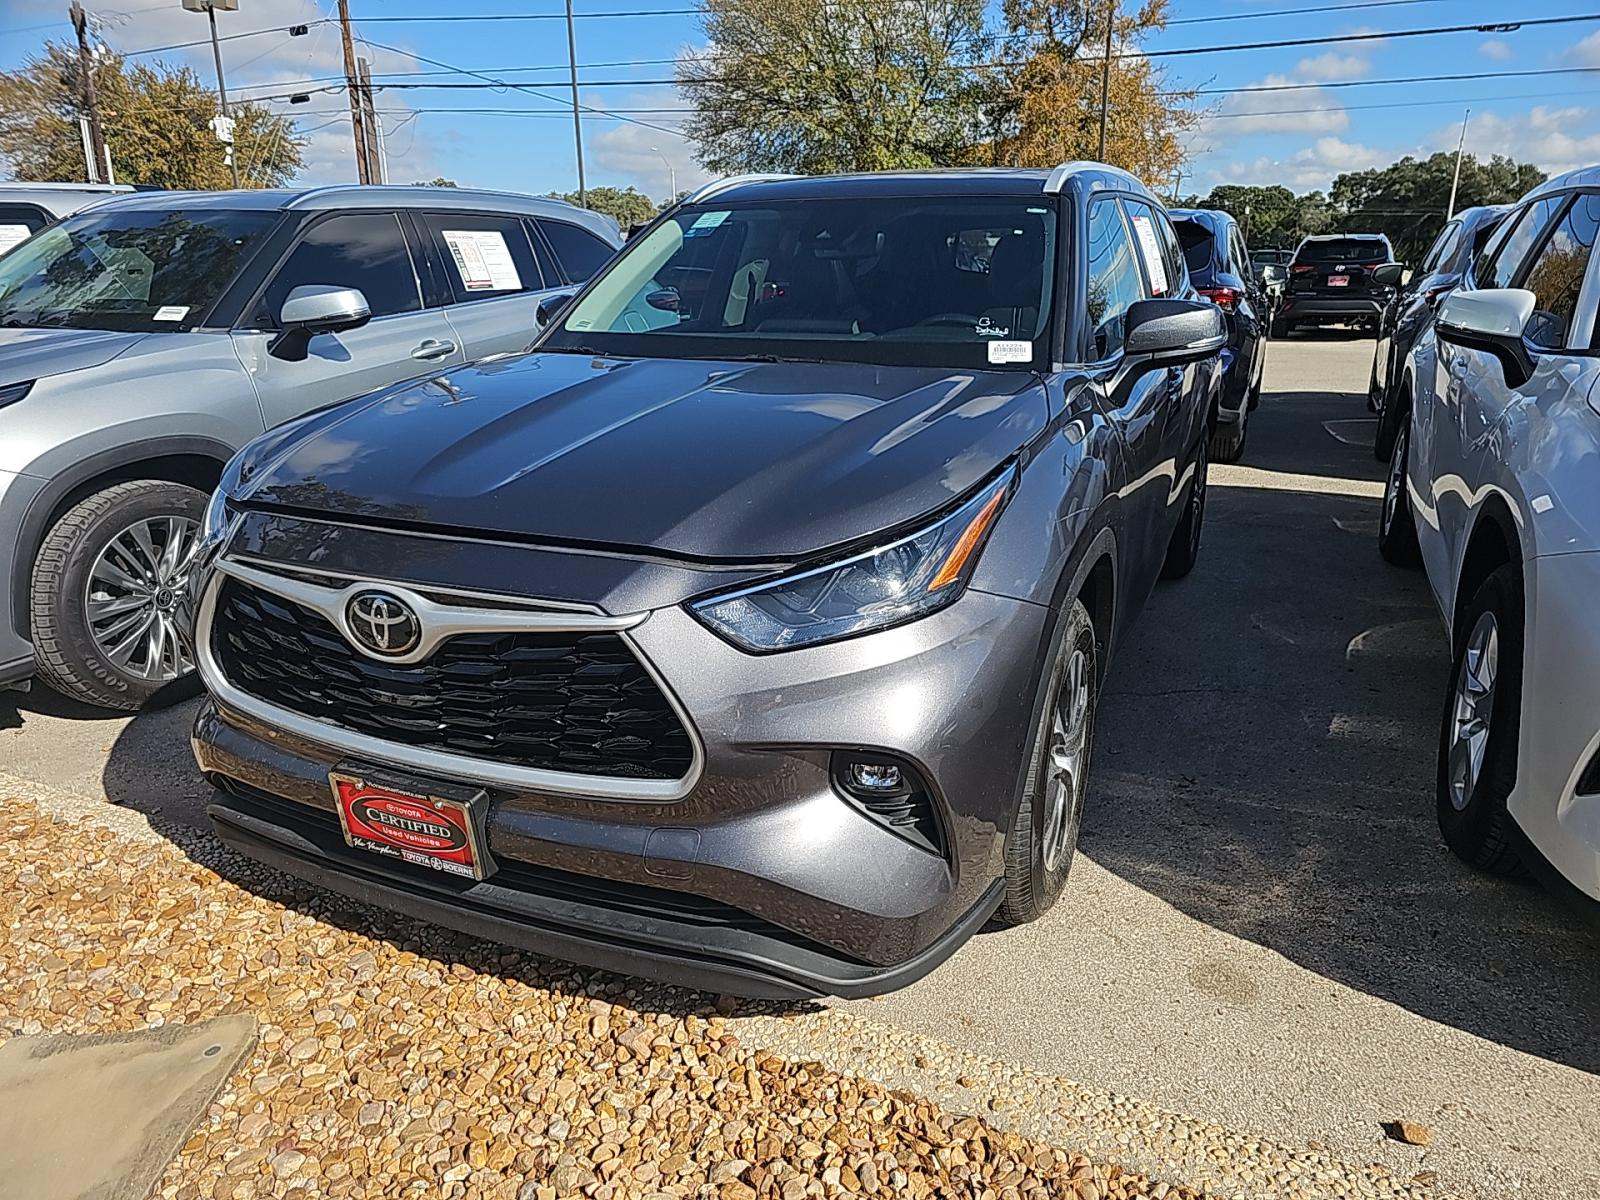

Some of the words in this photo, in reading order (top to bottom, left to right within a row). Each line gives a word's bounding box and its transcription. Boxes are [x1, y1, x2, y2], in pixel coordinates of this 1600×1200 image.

[394, 805, 422, 818] TOYOTA
[366, 807, 451, 838] CERTIFIED
[382, 826, 403, 838] Used
[404, 832, 441, 847] Vehicles
[402, 851, 431, 866] TOYOTA
